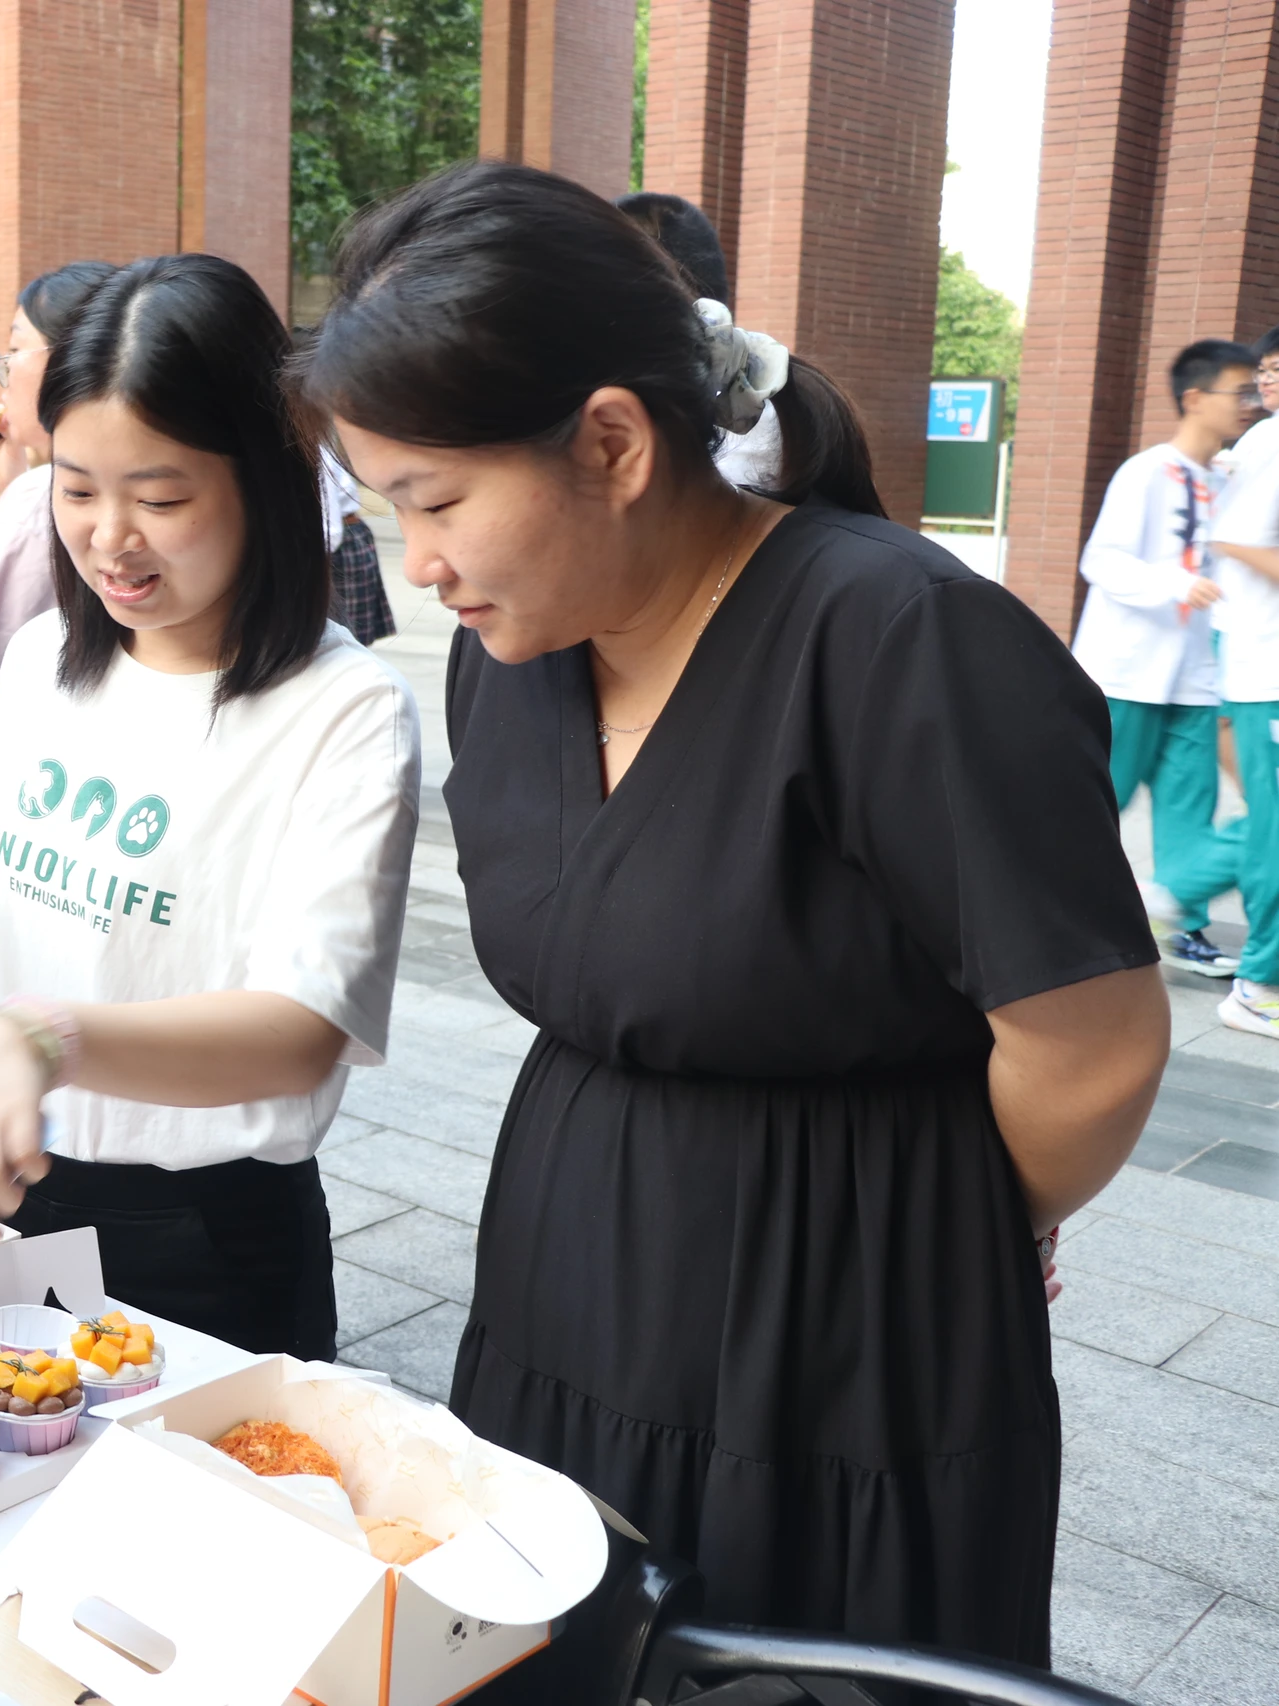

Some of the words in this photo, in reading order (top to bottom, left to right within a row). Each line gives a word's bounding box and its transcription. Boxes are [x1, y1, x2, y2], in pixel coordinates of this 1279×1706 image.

[9, 876, 86, 920] ENTHUSIASM
[90, 913, 112, 934] IFE
[86, 867, 177, 926] LIFE
